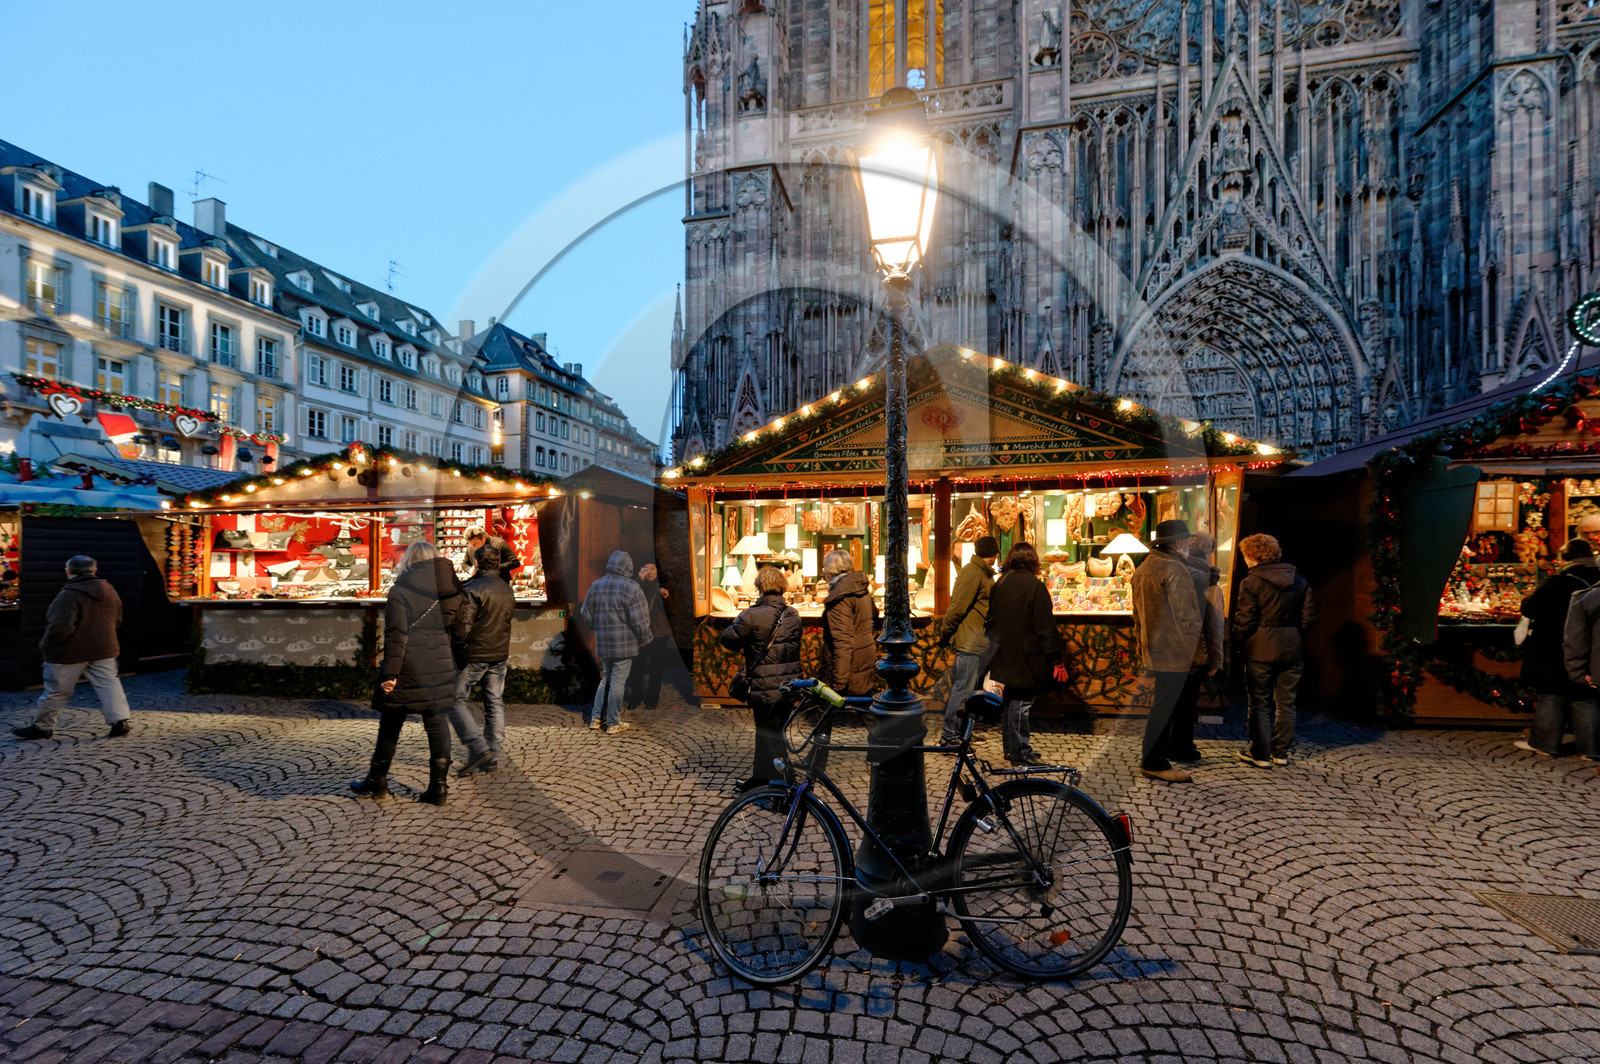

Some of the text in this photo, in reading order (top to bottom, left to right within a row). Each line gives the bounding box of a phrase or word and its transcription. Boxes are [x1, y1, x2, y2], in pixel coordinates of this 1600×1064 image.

[1030, 415, 1058, 429] Bonnes
[950, 445, 979, 453] Bonnes
[1013, 442, 1046, 450] Marché
[1048, 441, 1059, 449] de
[1061, 440, 1082, 448] Noël
